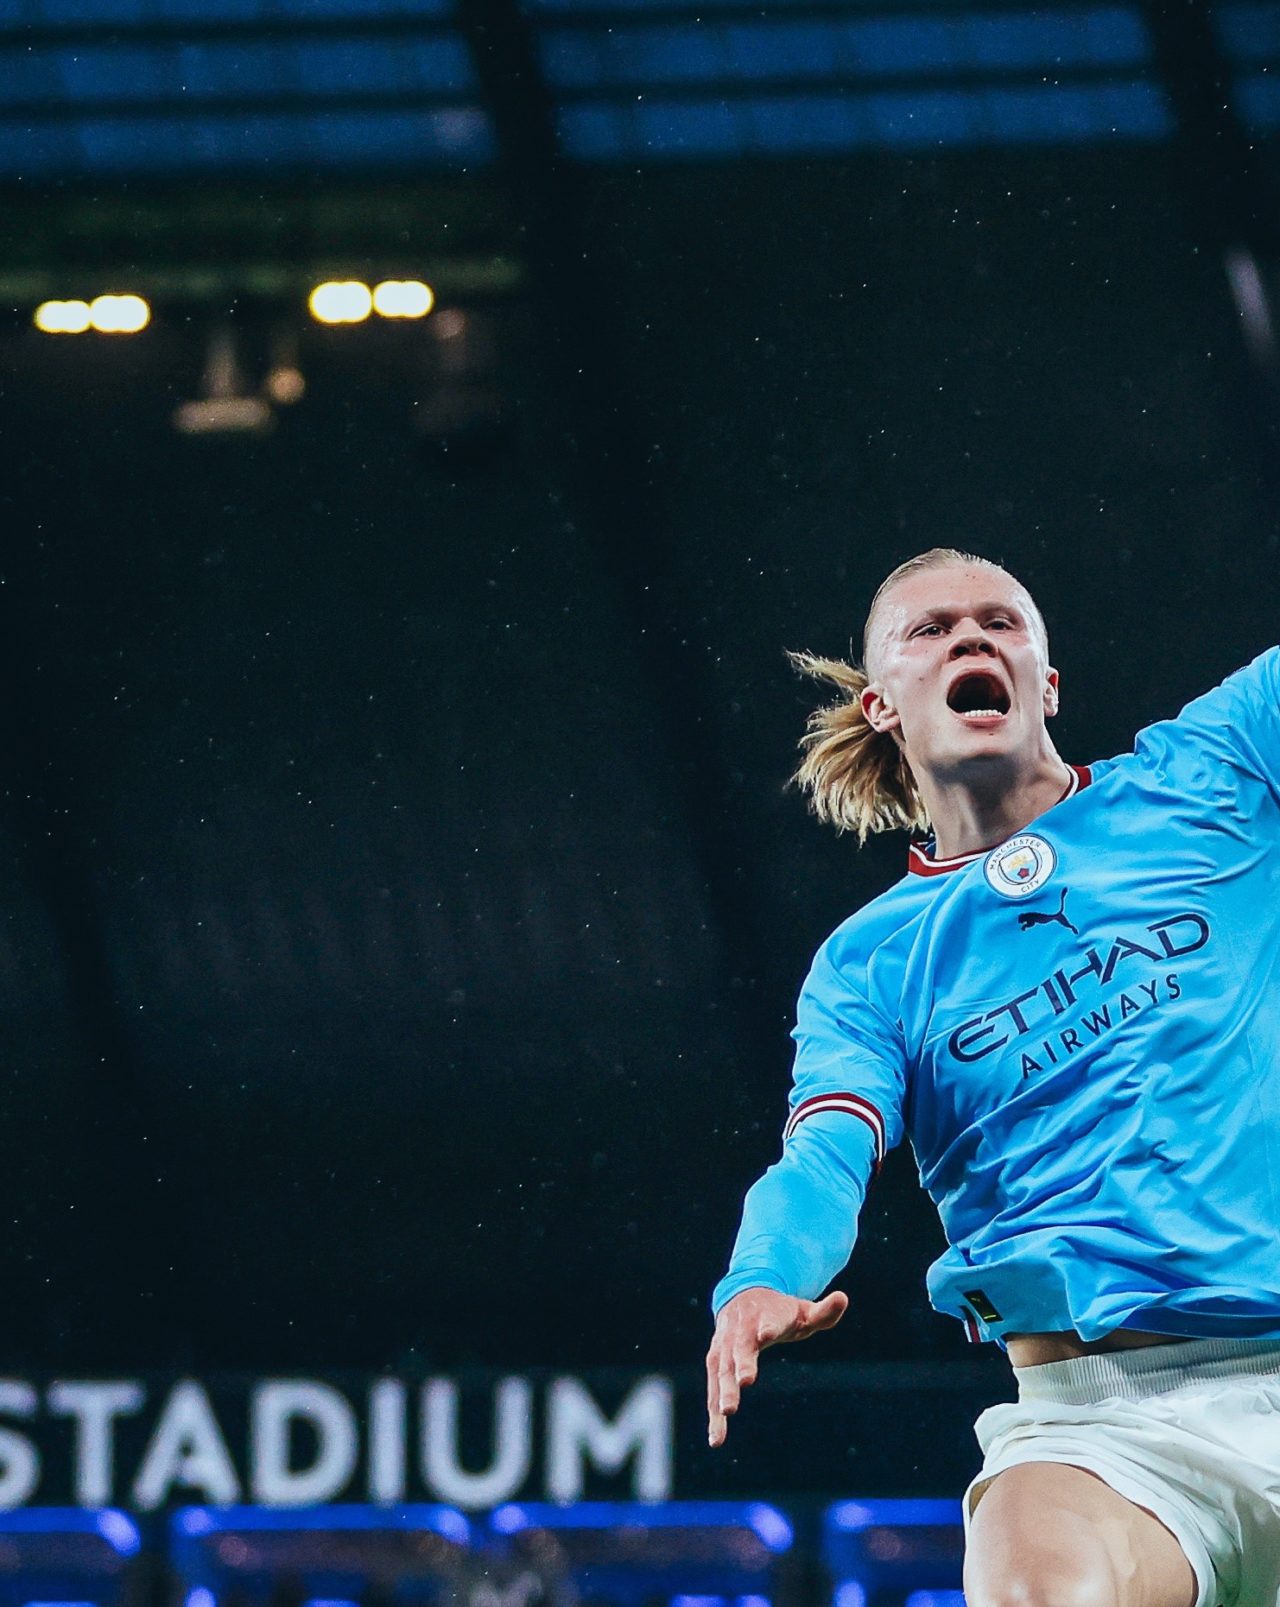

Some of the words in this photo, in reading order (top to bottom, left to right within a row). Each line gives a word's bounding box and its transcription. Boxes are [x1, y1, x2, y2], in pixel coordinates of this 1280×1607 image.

[989, 839, 1041, 870] MANCHESTER
[1021, 879, 1040, 893] CITY
[948, 913, 1210, 1063] ETIHAD
[1021, 973, 1182, 1080] AIRWAYS
[0, 1376, 674, 1508] STADIUM
